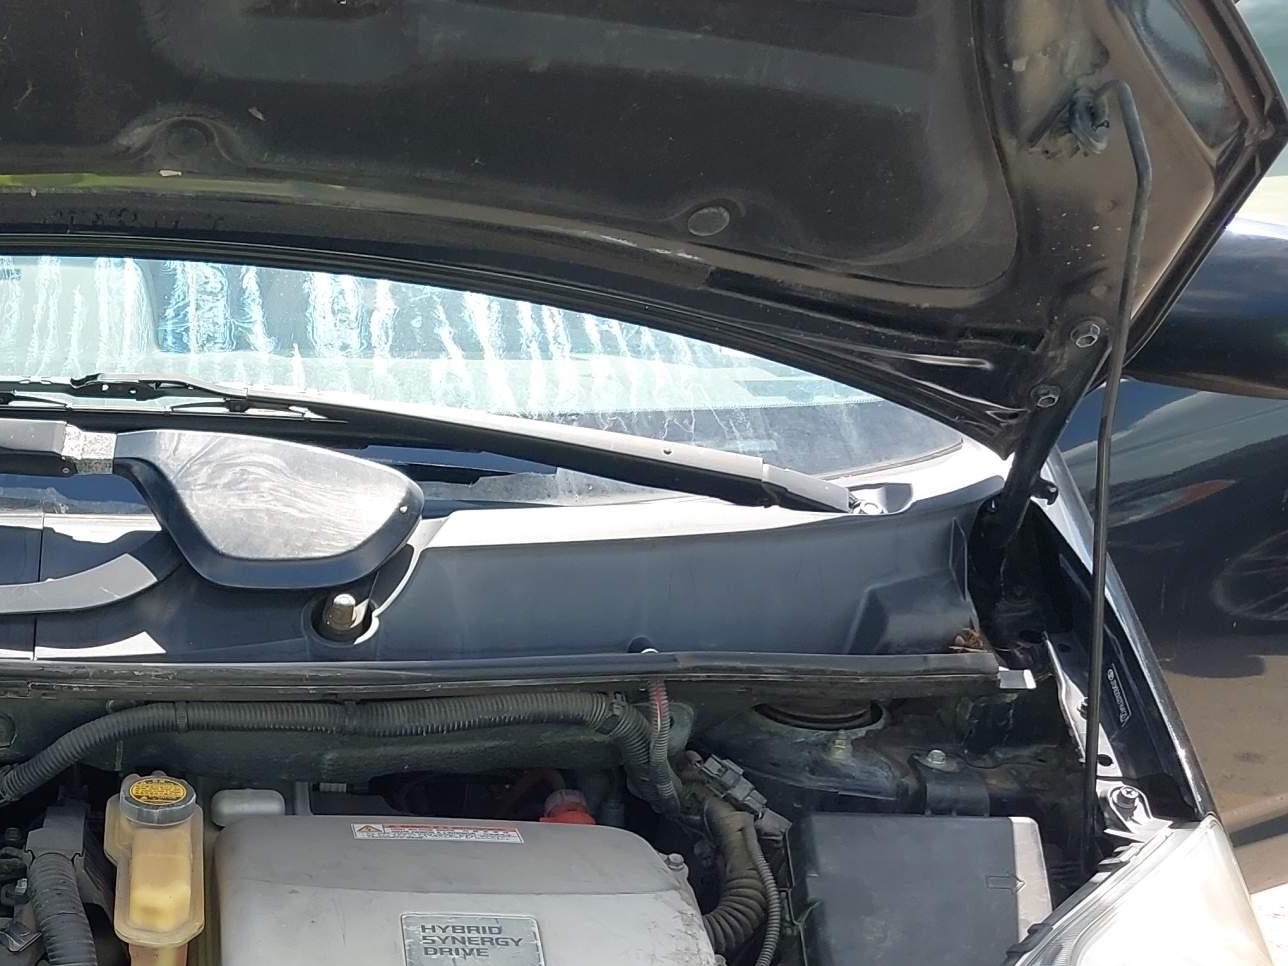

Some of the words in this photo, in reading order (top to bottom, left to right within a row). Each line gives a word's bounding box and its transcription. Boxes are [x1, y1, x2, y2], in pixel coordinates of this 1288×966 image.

[421, 925, 503, 935] HYBRID
[422, 936, 523, 947] SYNERGY
[423, 947, 489, 957] DRIVE
